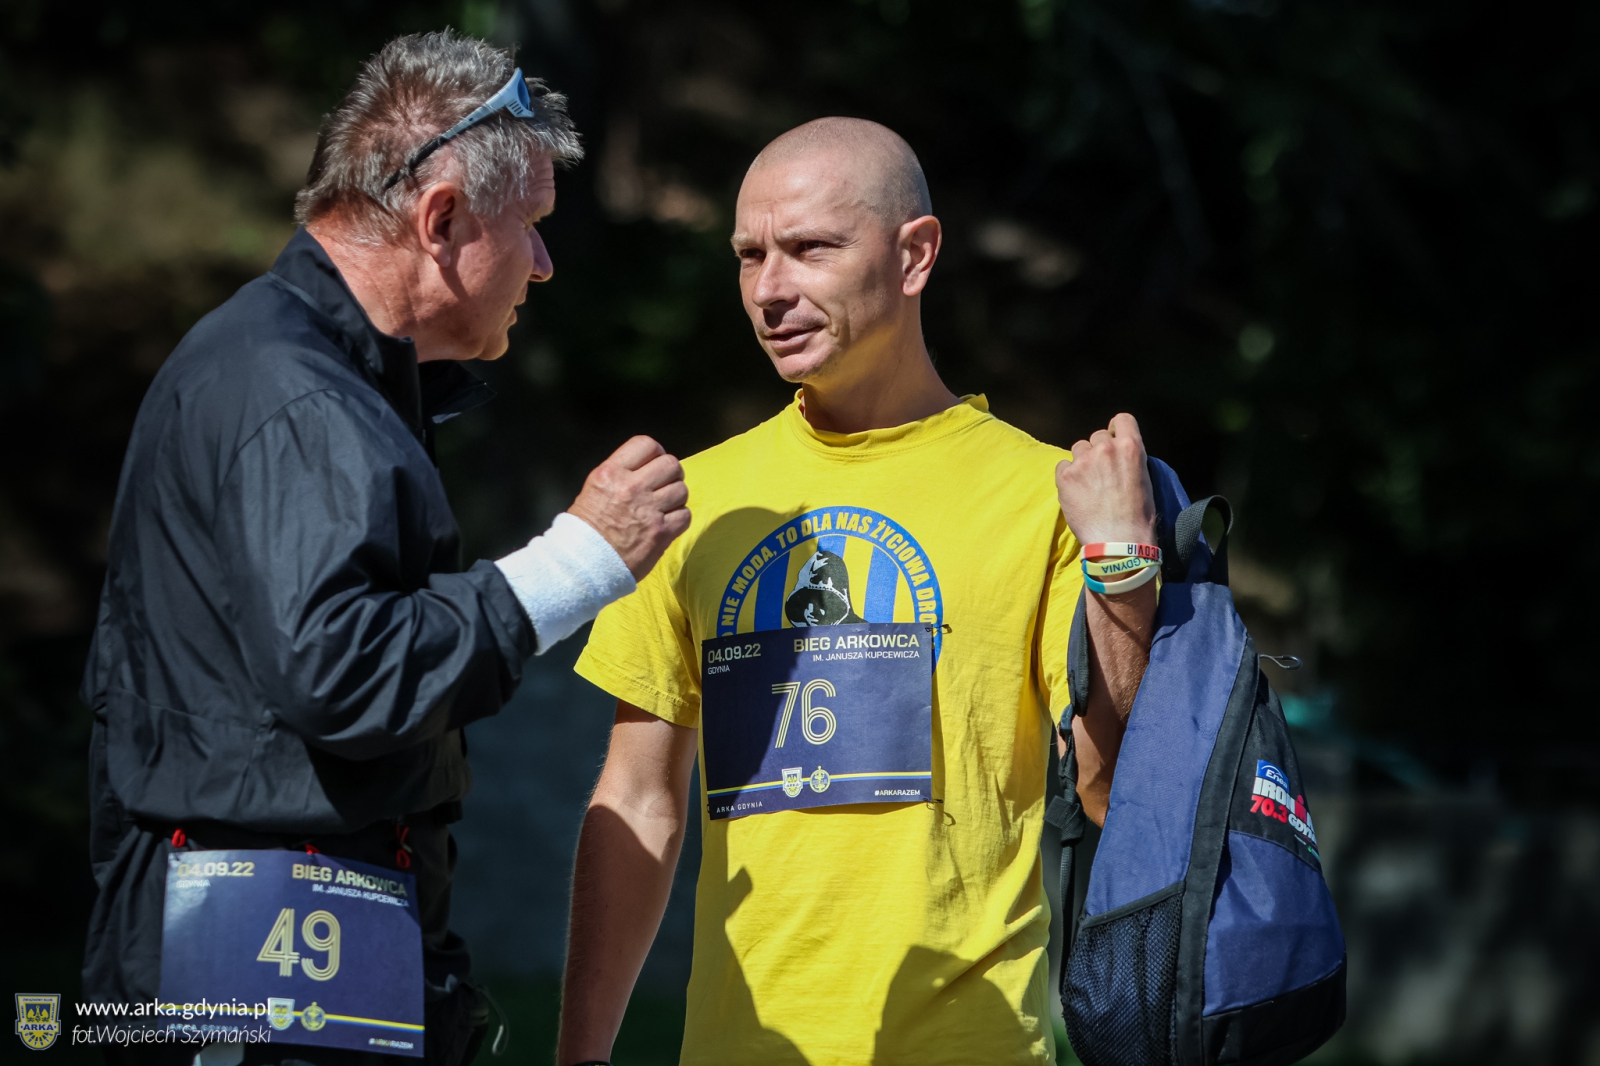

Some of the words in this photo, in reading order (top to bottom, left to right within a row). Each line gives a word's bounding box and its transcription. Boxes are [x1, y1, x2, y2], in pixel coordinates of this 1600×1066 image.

[721, 596, 740, 626] NIE
[731, 546, 778, 595] MODA,
[775, 526, 798, 549] TO
[801, 512, 832, 535] DLA
[836, 511, 873, 534] NAS
[870, 519, 930, 587] ŻYCIOWA
[915, 587, 938, 638] DRO
[1101, 557, 1142, 574] GDYNIA
[708, 643, 762, 664] 04.09.22
[793, 636, 831, 653] BIEG
[835, 634, 920, 650] ARKOWCA
[812, 652, 824, 662] IM.
[825, 651, 863, 661] JANUSZA
[865, 649, 920, 660] KUPCEWICZA
[708, 664, 730, 675] GDYNIA
[771, 678, 837, 749] 76
[874, 788, 921, 797] #ARKARAZEM
[716, 805, 735, 814] ARKA
[737, 801, 763, 811] GDYNIA
[1250, 794, 1288, 823] 70.3
[1252, 776, 1315, 834] IRONMA
[177, 861, 255, 878] 04.09.22
[292, 863, 333, 882] BIEG
[334, 869, 408, 897] ARKOWCA
[256, 908, 341, 981] 49
